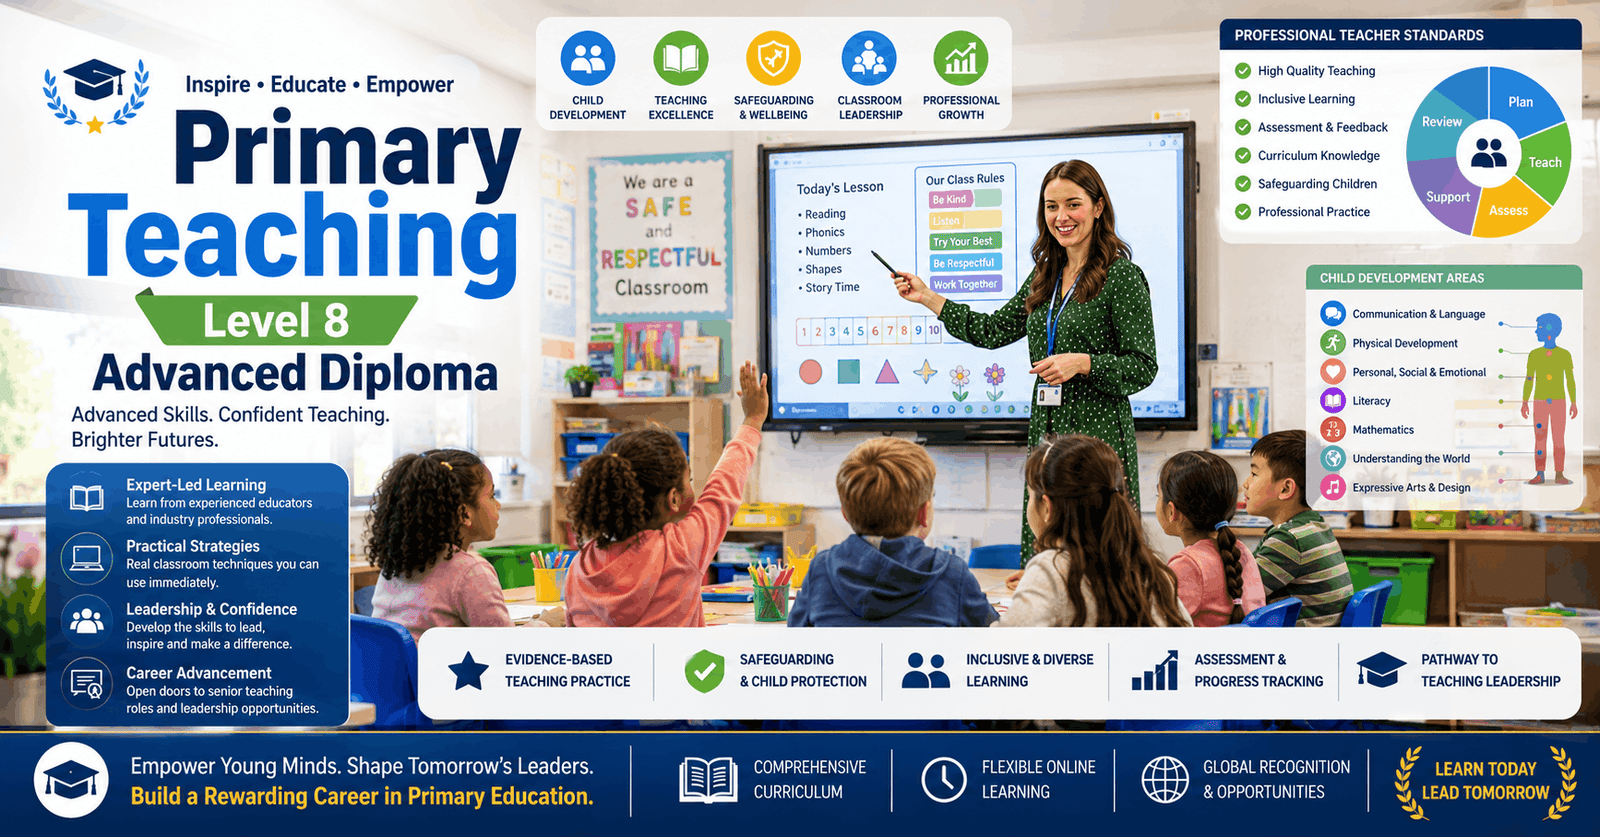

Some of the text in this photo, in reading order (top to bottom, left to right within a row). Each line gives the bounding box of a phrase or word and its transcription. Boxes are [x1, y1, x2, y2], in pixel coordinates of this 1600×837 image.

[623, 175, 693, 190] We are a
[925, 172, 1005, 186] Our Class Rules
[796, 181, 884, 197] Today's Lesson
[932, 194, 967, 205] Be Kind
[625, 195, 692, 219] SAFE
[805, 208, 846, 221] Reading
[932, 216, 960, 226] Listen
[645, 223, 672, 239] and
[805, 226, 845, 238] Phonics
[933, 236, 993, 249] Try Your Best
[805, 245, 852, 257] Numbers
[601, 246, 722, 270] RESPECTFUL
[933, 257, 995, 270] Be Respectful
[805, 263, 843, 277] Shapes
[615, 278, 709, 297] Classroom
[805, 281, 860, 295] Story Time
[933, 279, 998, 291] Work Together
[815, 326, 822, 337] 2
[829, 326, 836, 337] 3
[842, 326, 850, 336] 4
[857, 325, 865, 337] 5
[871, 325, 879, 337] 6
[887, 325, 894, 336] 7
[901, 325, 908, 336] 8
[915, 325, 922, 336] 9
[928, 325, 940, 335] 10
